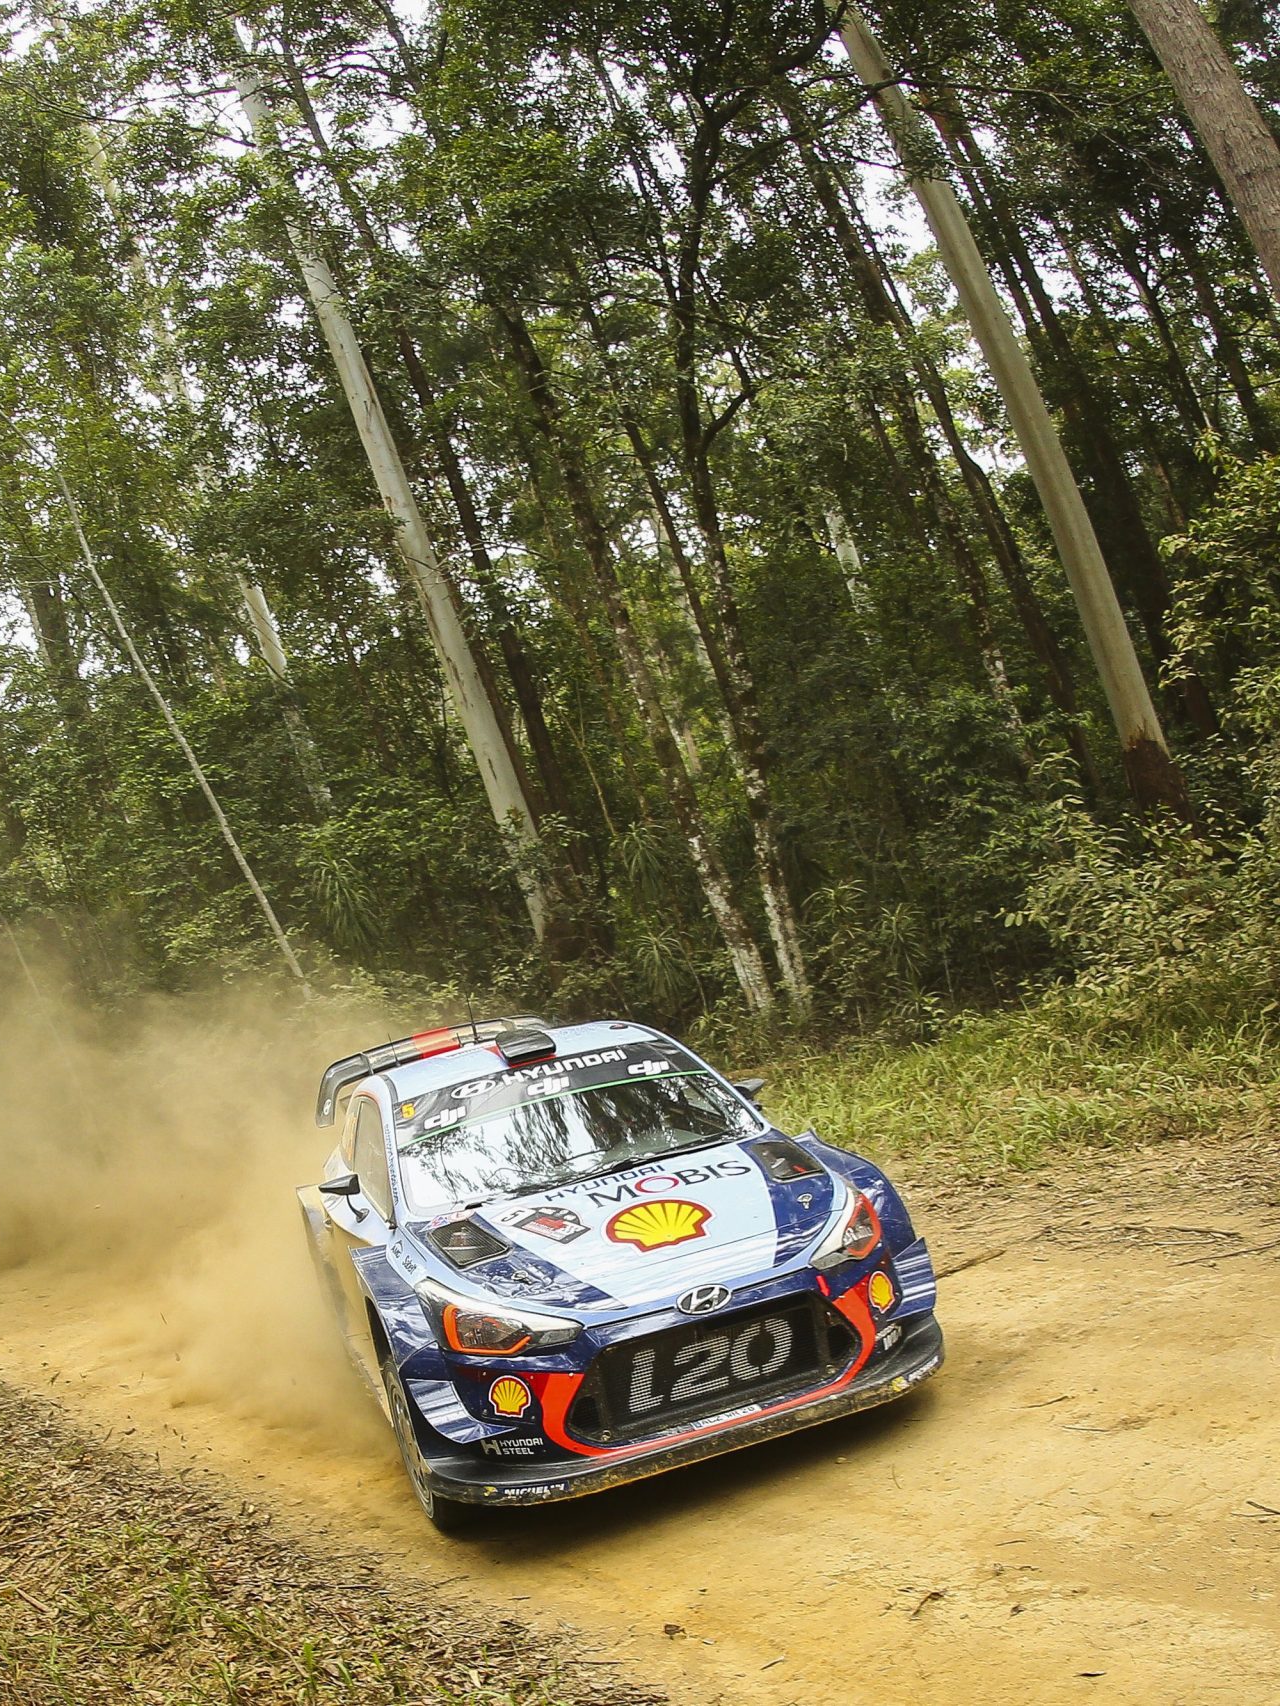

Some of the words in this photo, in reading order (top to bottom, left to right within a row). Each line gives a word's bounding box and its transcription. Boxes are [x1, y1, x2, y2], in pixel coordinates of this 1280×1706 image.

[501, 1050, 628, 1086] HYUNDAI
[627, 1059, 670, 1076] dji
[527, 1075, 570, 1097] dji
[400, 1102, 415, 1119] 5
[423, 1105, 467, 1130] dji
[544, 1164, 668, 1201] HYUNDAI
[586, 1160, 753, 1208] MOBIS
[500, 1209, 526, 1223] 5
[500, 1437, 544, 1447] HYUNDAI
[503, 1447, 535, 1455] STEEL
